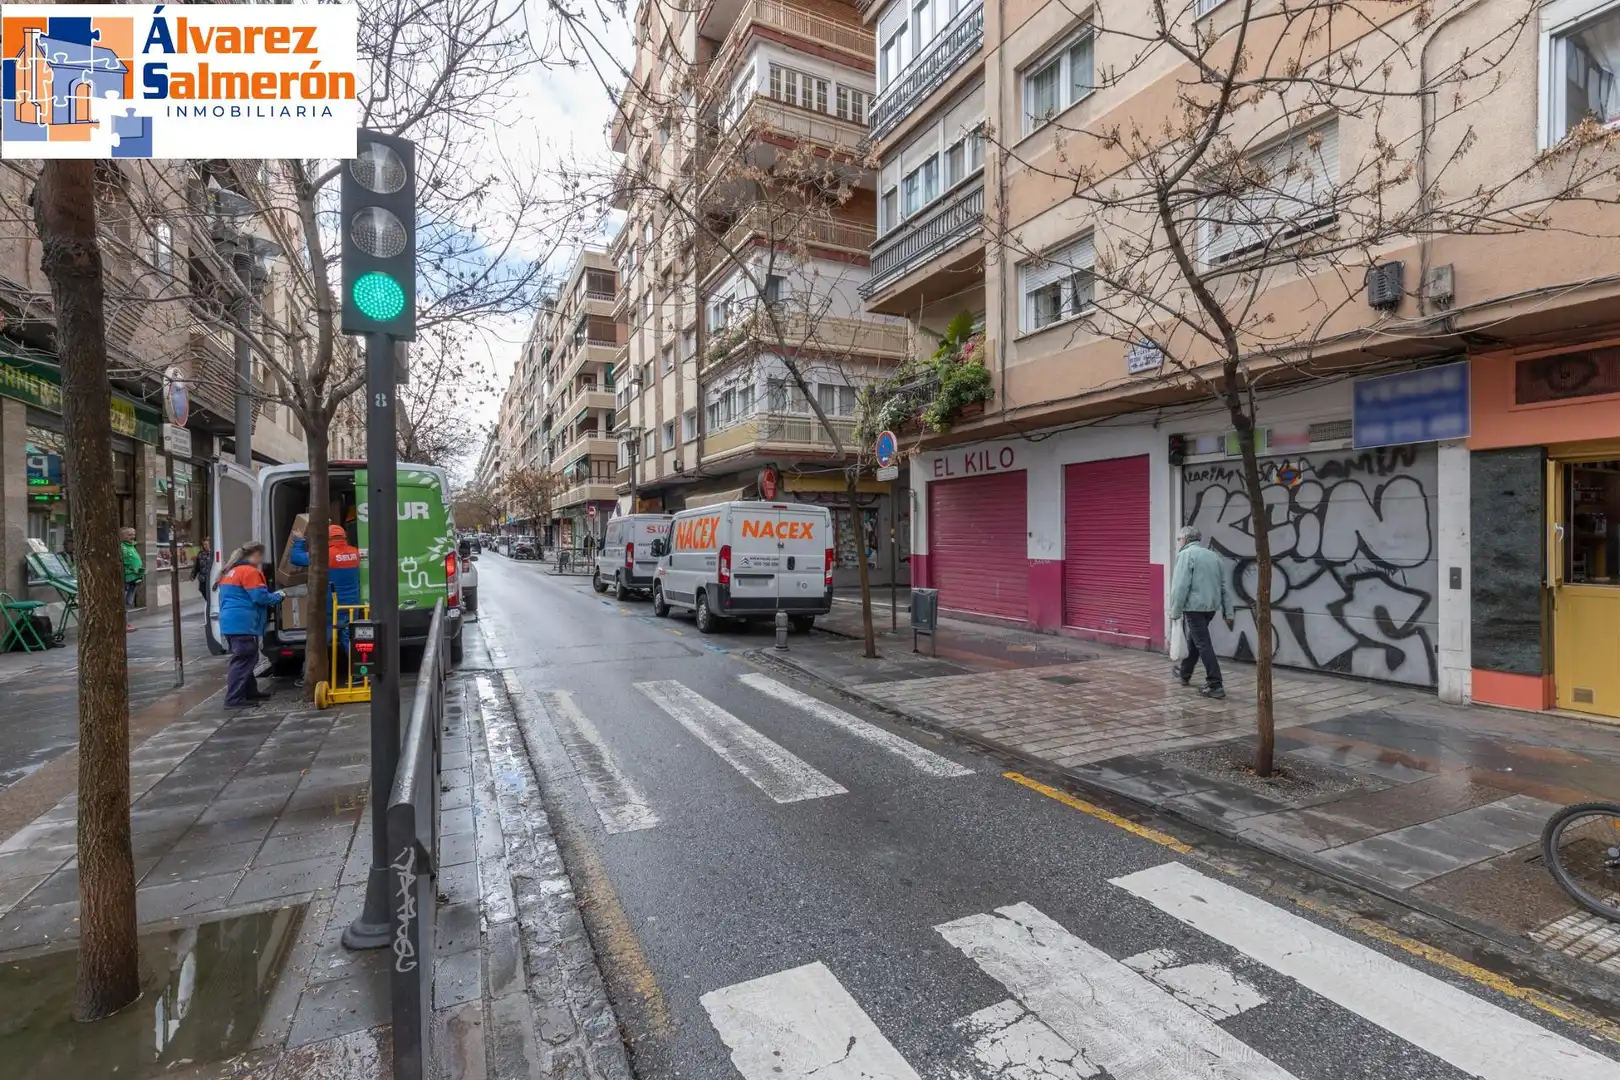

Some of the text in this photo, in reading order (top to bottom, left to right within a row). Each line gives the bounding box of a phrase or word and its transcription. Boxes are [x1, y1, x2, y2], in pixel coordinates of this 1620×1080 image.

[934, 446, 1014, 477] EL KILO
[357, 501, 430, 522] SUR
[675, 516, 721, 550] NACEX
[742, 520, 815, 540] NACEX
[335, 553, 358, 562] SEUR
